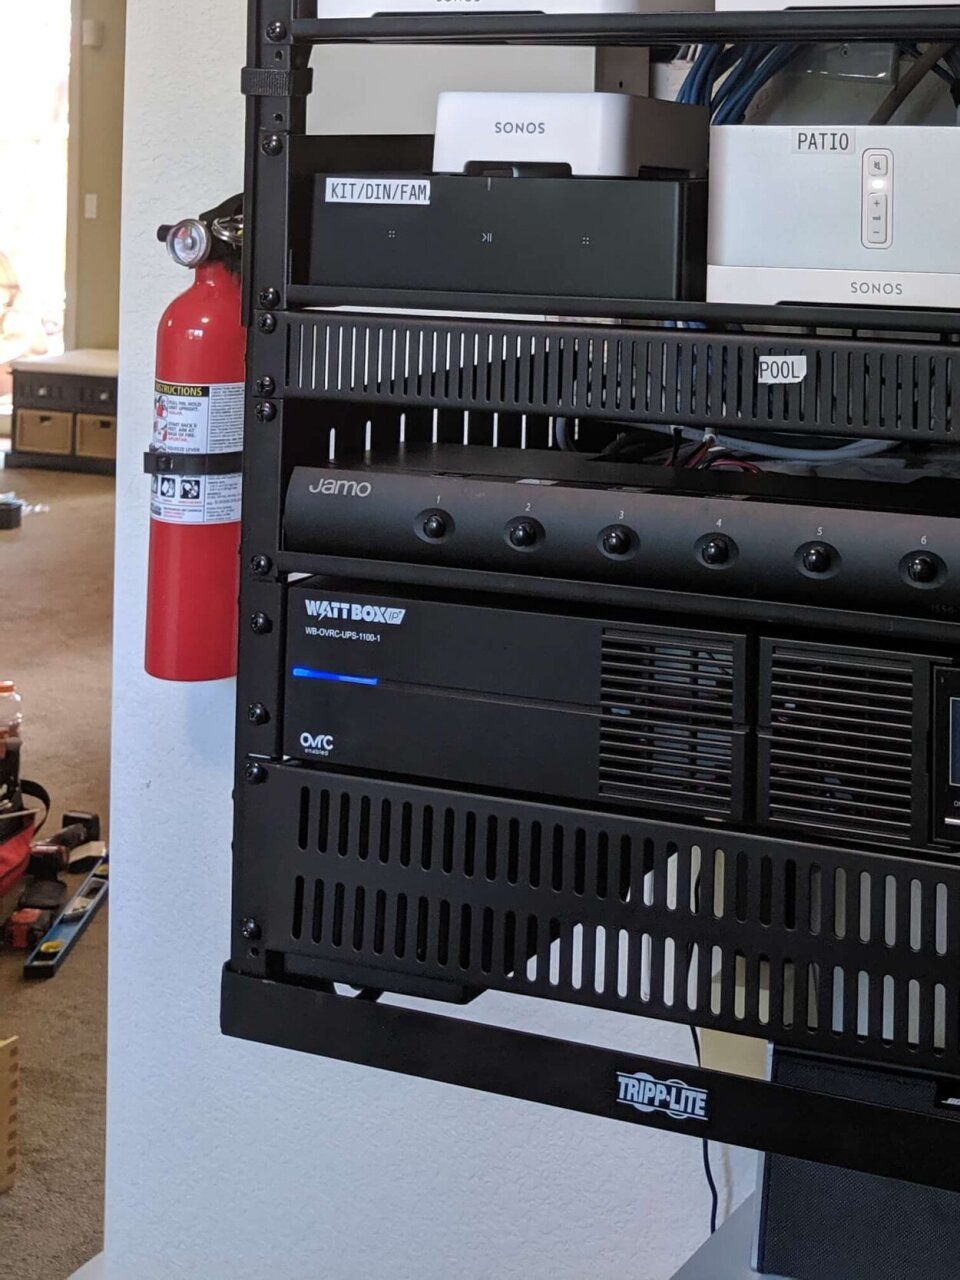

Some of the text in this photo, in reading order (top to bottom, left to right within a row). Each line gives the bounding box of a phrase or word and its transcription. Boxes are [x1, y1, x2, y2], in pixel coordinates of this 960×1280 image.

[494, 122, 546, 135] SONOS
[797, 131, 849, 152] PATIO
[850, 281, 904, 296] SONOS
[759, 360, 801, 380] POOL
[308, 477, 372, 497] Jamo
[436, 495, 928, 545] 1 2 3 4 5 6
[305, 626, 381, 642] WB-OVRC-UPS-1100-1
[304, 748, 329, 756] enabled
